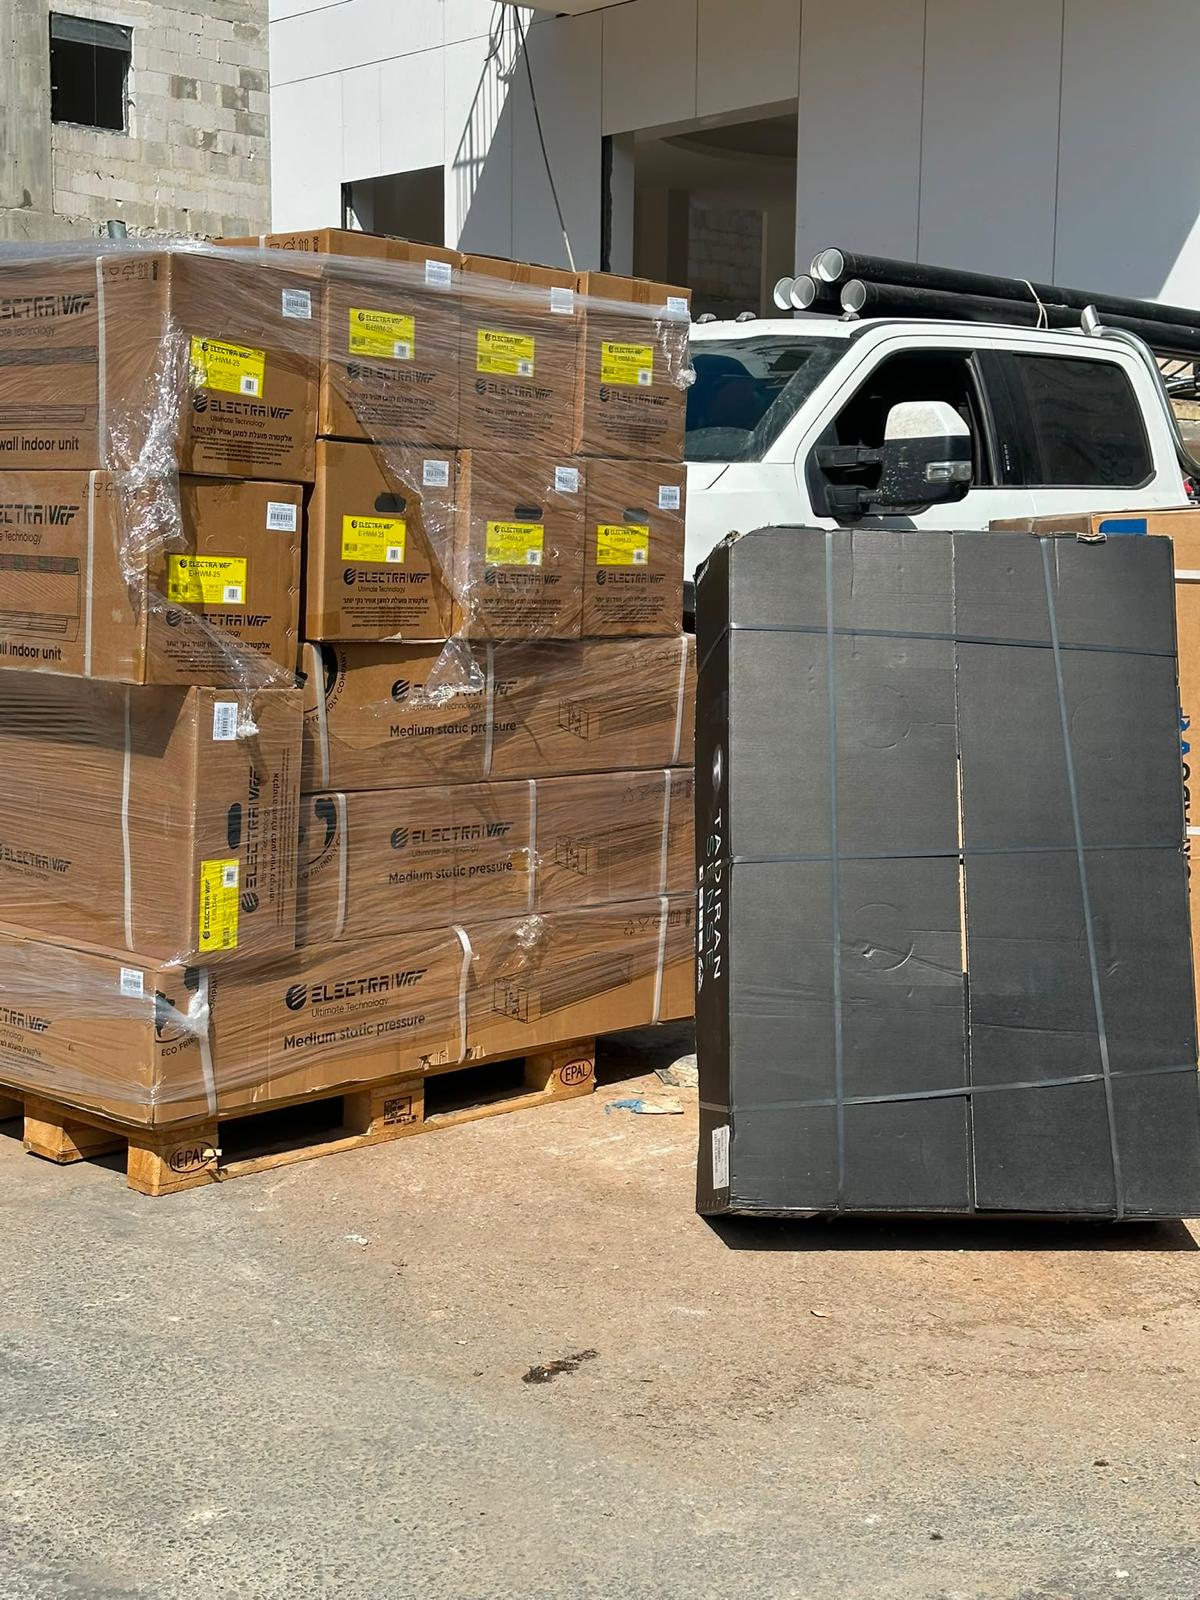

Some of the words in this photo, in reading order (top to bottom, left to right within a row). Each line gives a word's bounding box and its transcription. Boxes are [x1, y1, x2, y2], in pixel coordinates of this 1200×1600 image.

[21, 436, 55, 451] indoor
[59, 436, 79, 451] unit
[5, 530, 42, 545] Technology
[10, 643, 39, 658] indoor
[42, 646, 62, 661] unit
[390, 724, 435, 738] Medium
[437, 722, 468, 735] static
[411, 828, 481, 844] ELECTRA
[388, 870, 433, 885] Medium
[435, 866, 466, 879] static
[468, 860, 513, 880] pressure
[713, 808, 722, 979] TADIRAN
[311, 975, 389, 1003] ELECTRA
[311, 1004, 345, 1018] Ultimate
[346, 997, 389, 1012] Technology
[283, 1029, 336, 1050] Medium
[340, 1022, 374, 1041] static
[377, 1014, 426, 1036] pressure
[161, 1046, 178, 1057] ECO
[565, 1063, 587, 1082] EPAL
[177, 1147, 208, 1169] EPAL
